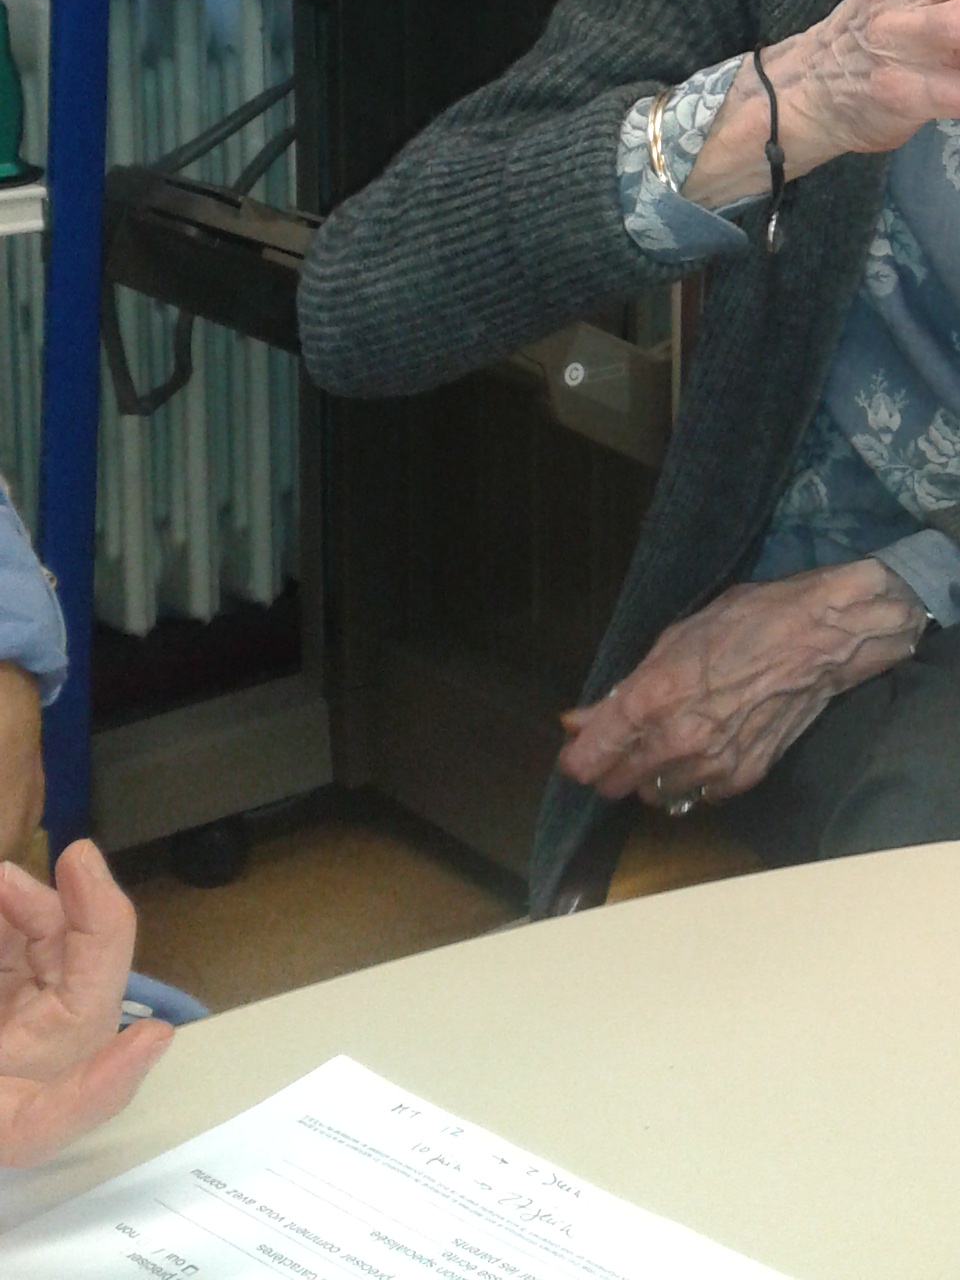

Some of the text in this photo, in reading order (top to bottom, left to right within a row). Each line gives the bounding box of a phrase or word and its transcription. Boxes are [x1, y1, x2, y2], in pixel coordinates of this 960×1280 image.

[189, 1168, 228, 1190] connu
[224, 1189, 257, 1206] avez
[255, 1205, 286, 1223] vous
[115, 1222, 140, 1239] non
[282, 1221, 341, 1254] comment
